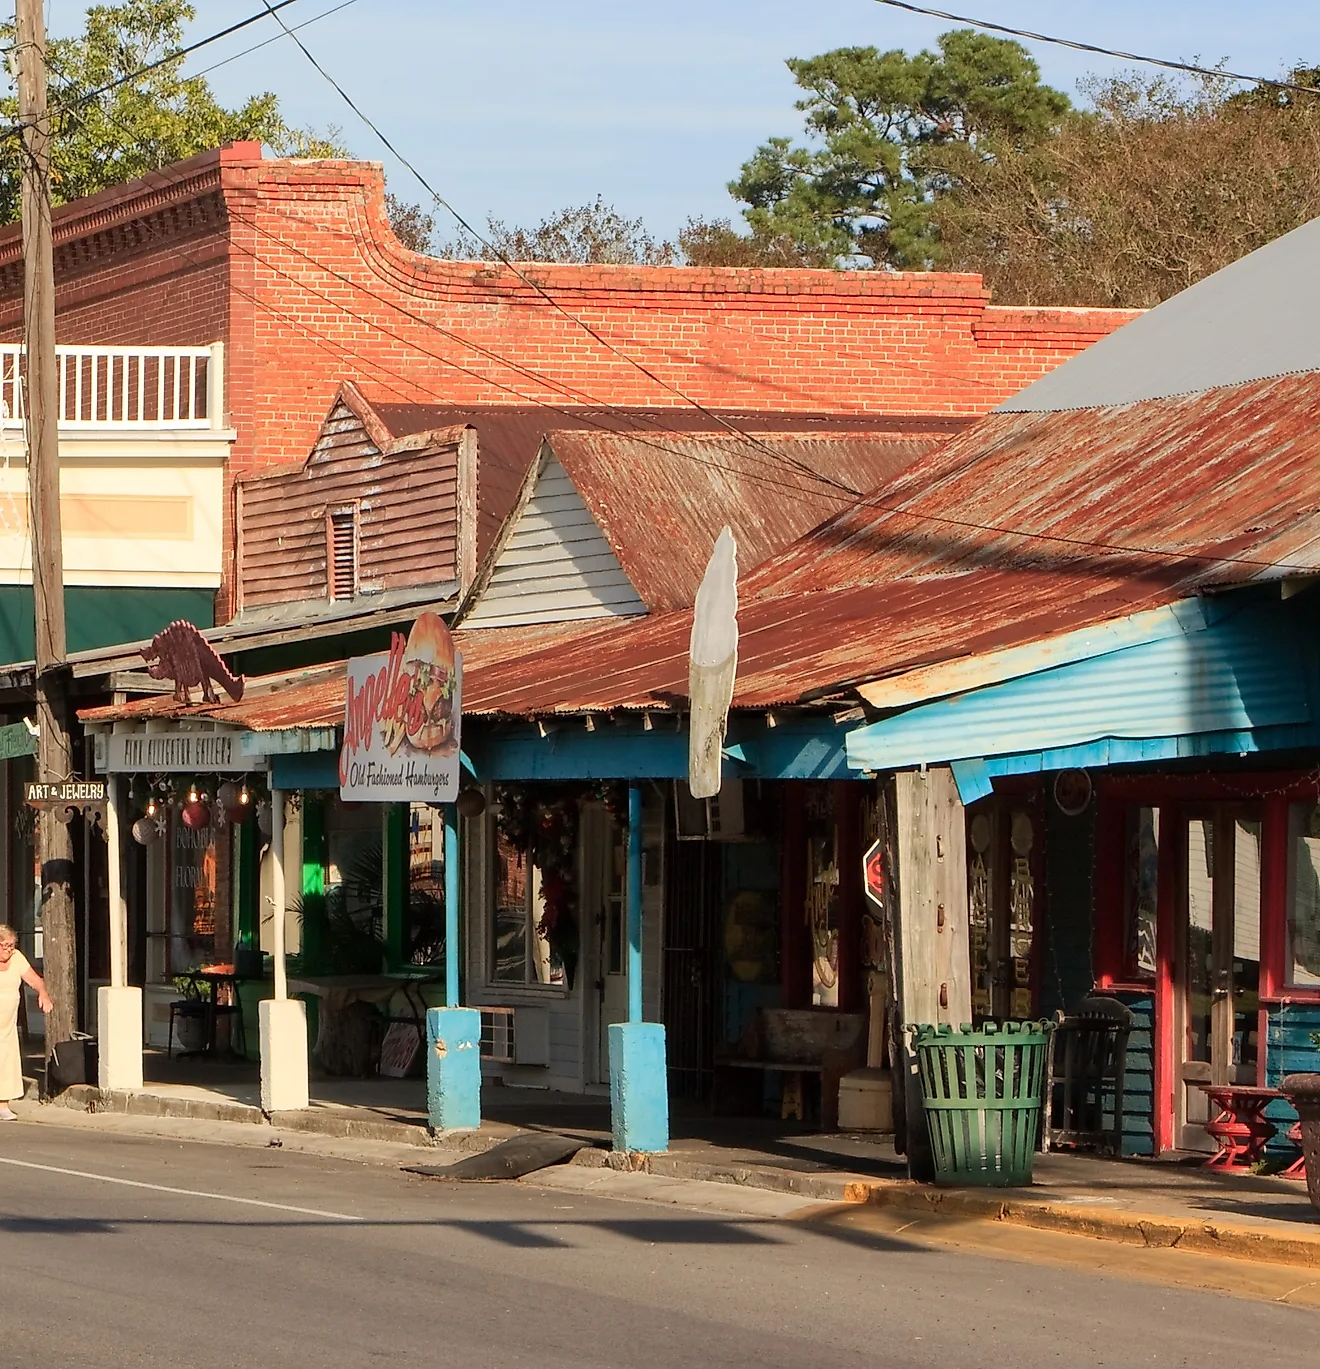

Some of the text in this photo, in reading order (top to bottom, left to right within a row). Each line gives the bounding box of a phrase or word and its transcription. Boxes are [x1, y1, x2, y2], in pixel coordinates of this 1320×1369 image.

[349, 761, 450, 796] Old Fashioned Hamburgers
[28, 784, 104, 800] ART & JEWELRY
